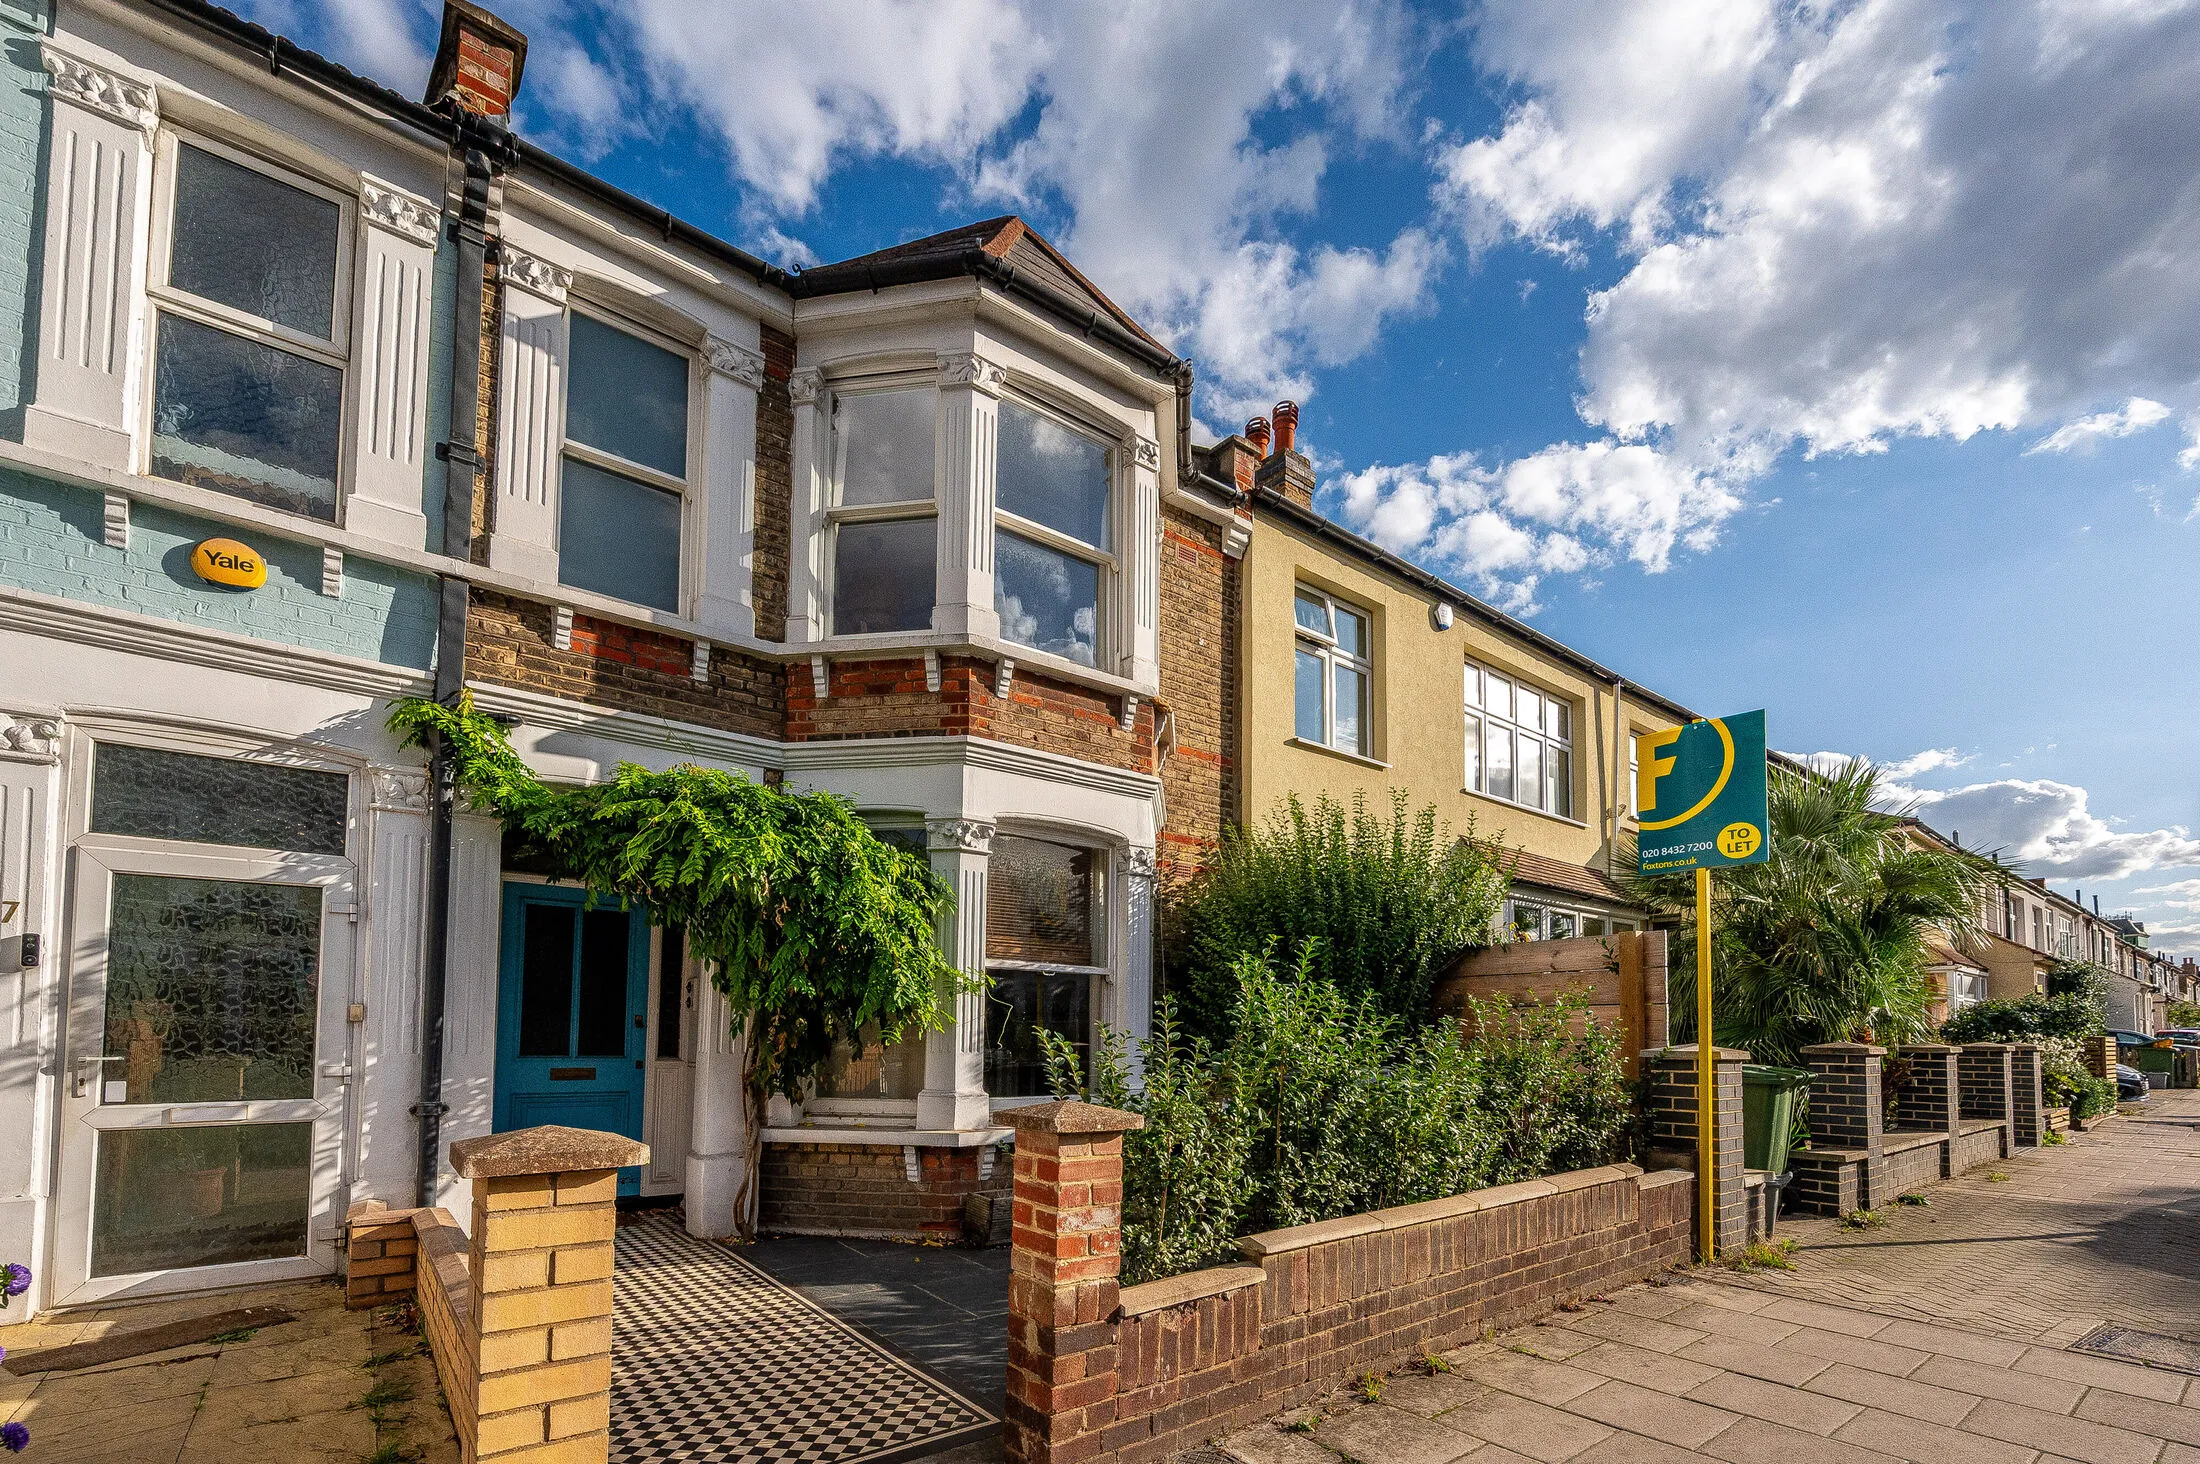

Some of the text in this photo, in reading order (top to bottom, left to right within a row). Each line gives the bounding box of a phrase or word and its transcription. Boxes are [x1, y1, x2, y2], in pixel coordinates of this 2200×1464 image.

[203, 549, 254, 572] Yale
[1637, 725, 1684, 812] F
[1727, 828, 1750, 840] TO
[1642, 841, 1713, 858] 020 8432 7200
[1727, 840, 1753, 853] LET
